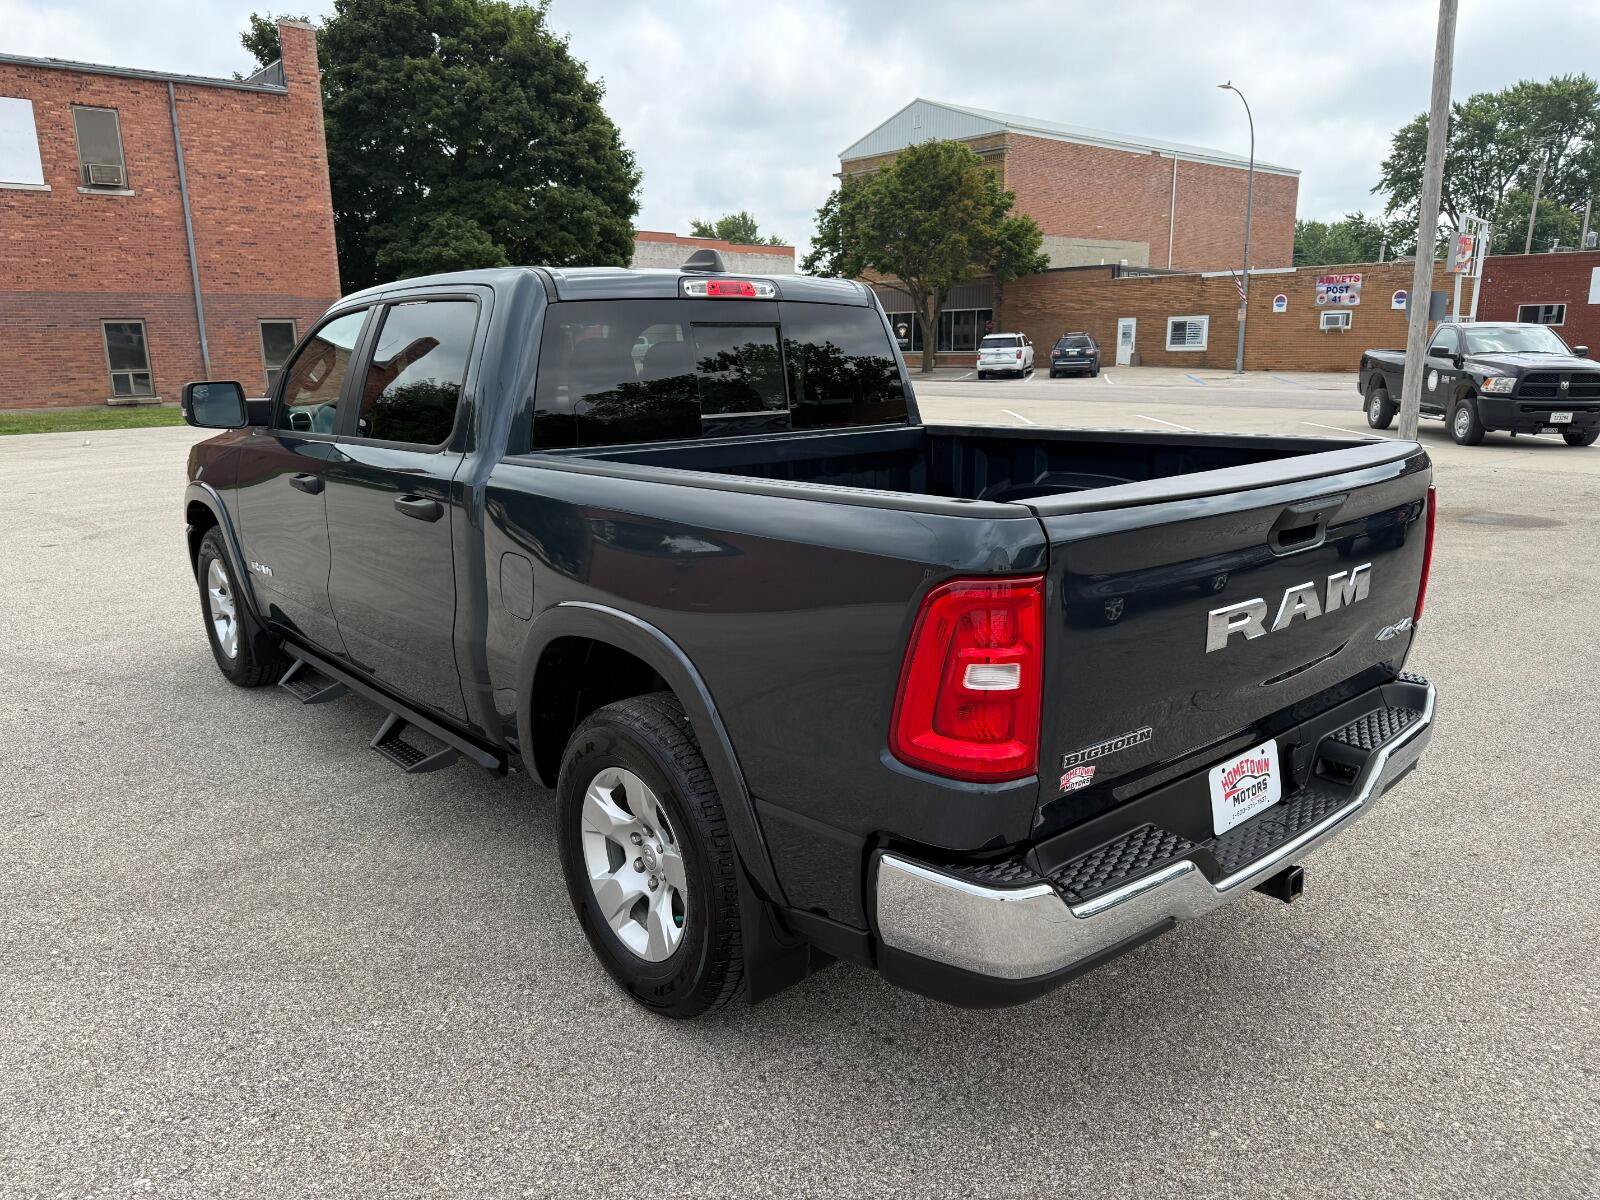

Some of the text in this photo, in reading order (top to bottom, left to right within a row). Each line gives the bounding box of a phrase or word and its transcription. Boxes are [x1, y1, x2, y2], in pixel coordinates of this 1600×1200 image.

[1319, 275, 1361, 284] AMVETS
[1326, 286, 1350, 294] POST
[1205, 562, 1372, 653] RAM
[1062, 726, 1152, 768] BIGHORN
[1060, 766, 1095, 786] HOMETOWN
[1222, 757, 1270, 793] HOMETOWN
[1233, 778, 1268, 807] MOTORS
